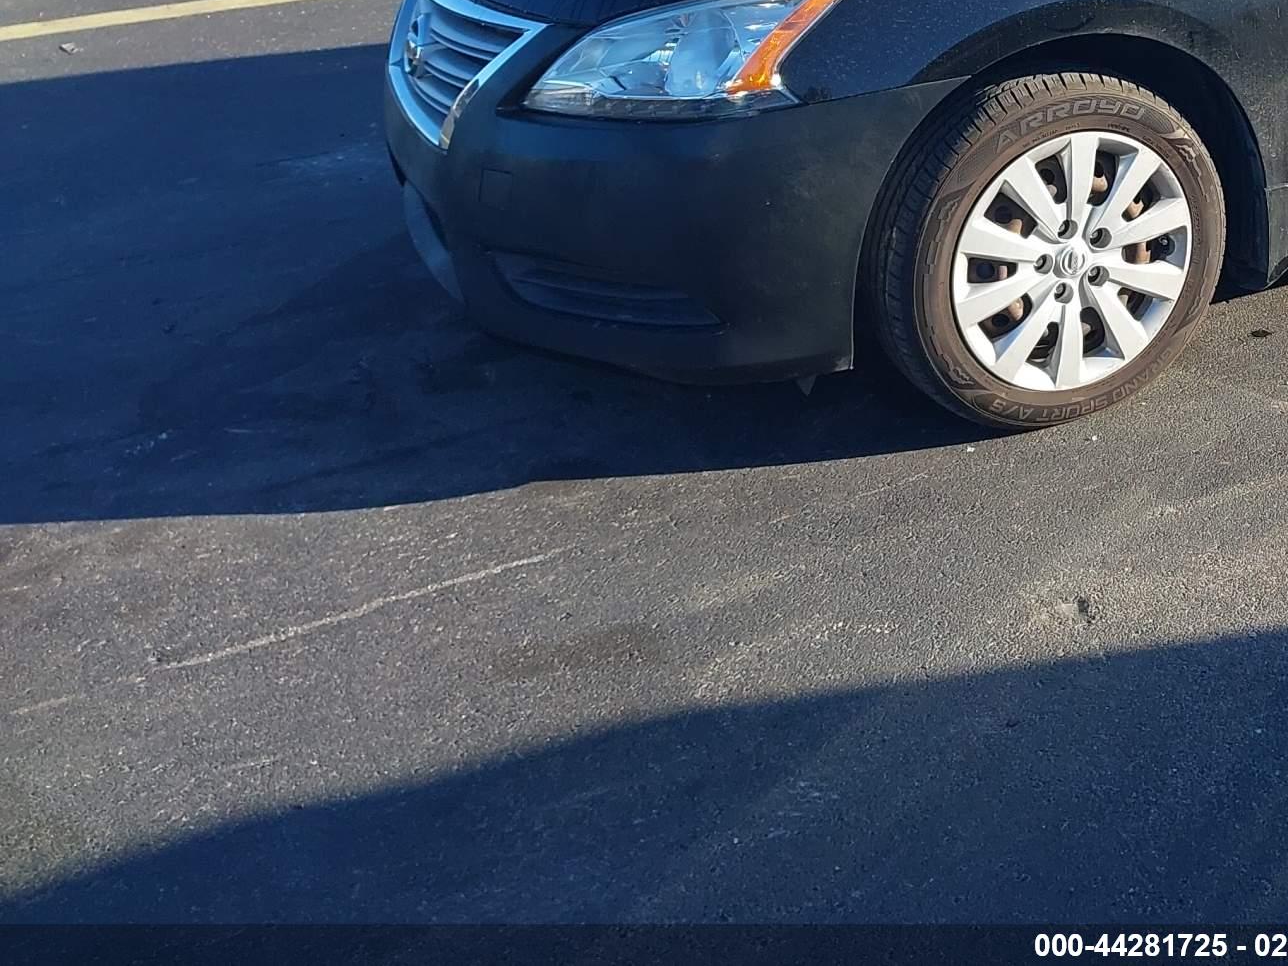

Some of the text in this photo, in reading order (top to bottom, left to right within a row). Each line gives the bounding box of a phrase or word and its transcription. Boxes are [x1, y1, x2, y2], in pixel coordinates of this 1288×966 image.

[994, 98, 1146, 153] ARROYO
[988, 346, 1174, 422] GRAND SPORT A/S
